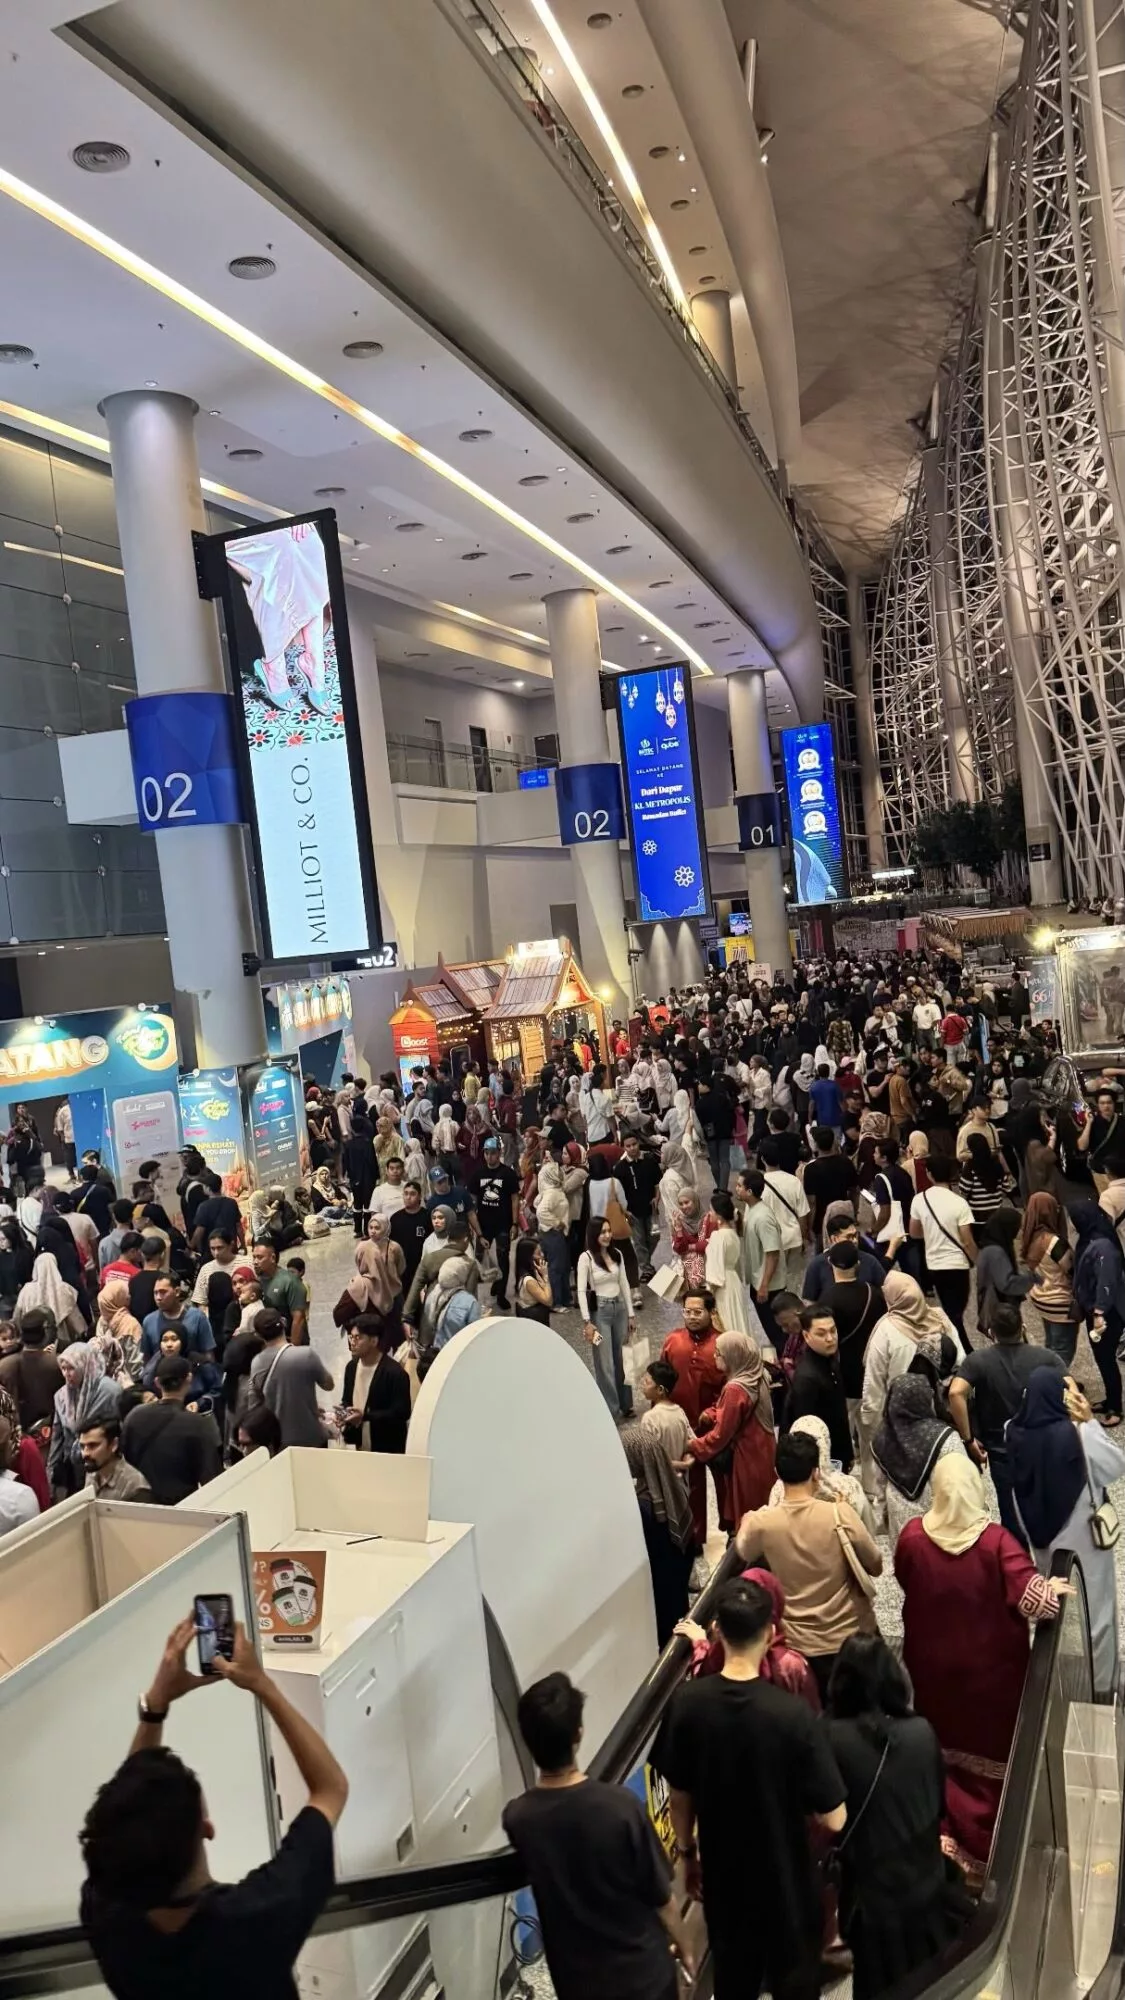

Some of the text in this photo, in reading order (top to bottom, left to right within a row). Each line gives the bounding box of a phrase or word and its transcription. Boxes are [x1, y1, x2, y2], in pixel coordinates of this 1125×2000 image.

[636, 767, 660, 775] SELAMAT
[141, 773, 197, 822] 02
[640, 785, 683, 796] Dari Dapur
[634, 796, 691, 810] KL METROPOLIS
[574, 810, 611, 840] 02
[751, 825, 775, 846] 01
[291, 756, 328, 944] MILLIOT & CO.
